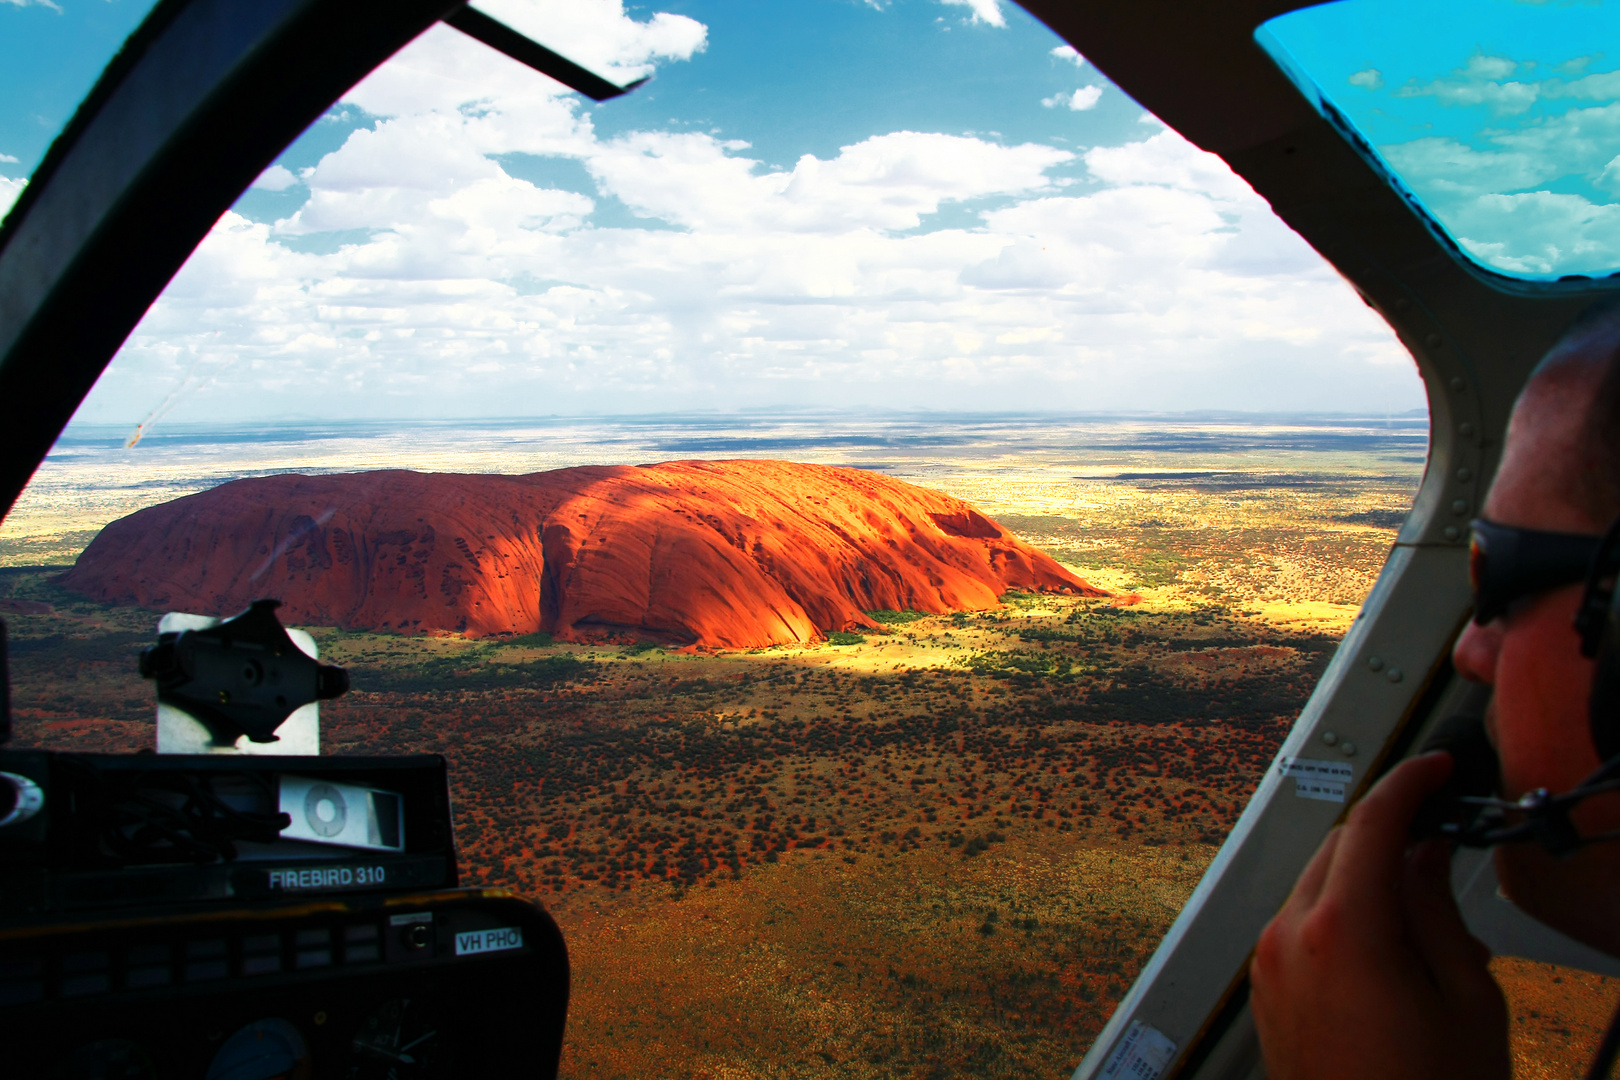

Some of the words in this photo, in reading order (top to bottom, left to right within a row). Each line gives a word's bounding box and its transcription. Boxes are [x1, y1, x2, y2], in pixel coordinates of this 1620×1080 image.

[269, 868, 352, 888] FIREBIRD
[356, 866, 385, 884] 310
[459, 934, 482, 951] VH
[486, 930, 519, 948] PHO
